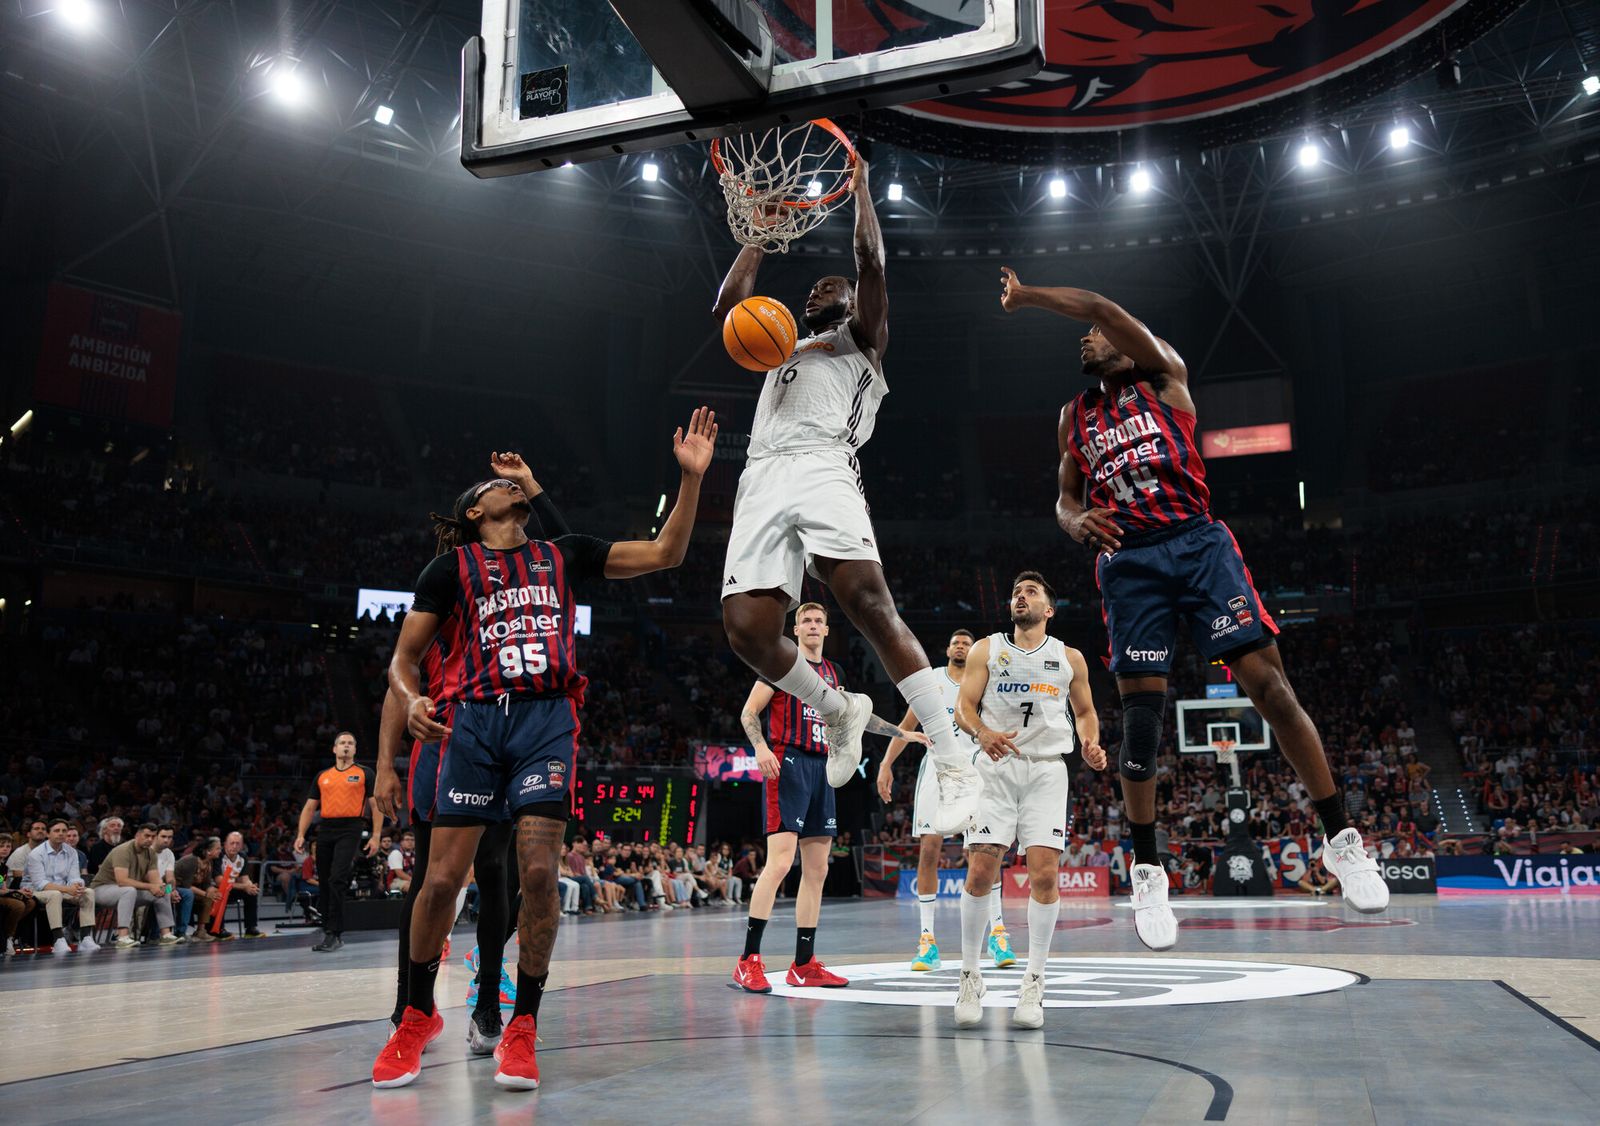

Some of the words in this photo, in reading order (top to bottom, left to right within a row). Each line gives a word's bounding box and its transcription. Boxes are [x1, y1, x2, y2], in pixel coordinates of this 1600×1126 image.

[526, 89, 557, 102] PLAYOFF
[68, 333, 152, 366] AMBICIÓN
[774, 361, 801, 388] 16
[1080, 411, 1162, 470] BASKONIA
[1106, 465, 1160, 505] 44
[475, 585, 561, 622] BASKONIA
[1211, 623, 1239, 641] HYUNDAI
[499, 642, 548, 679] 95
[997, 683, 1060, 697] AUTOHERO
[1020, 702, 1034, 728] 7
[519, 783, 547, 796] HYUNDAI
[619, 785, 629, 798] 2
[637, 785, 655, 799] 44
[613, 806, 642, 822] 2:24
